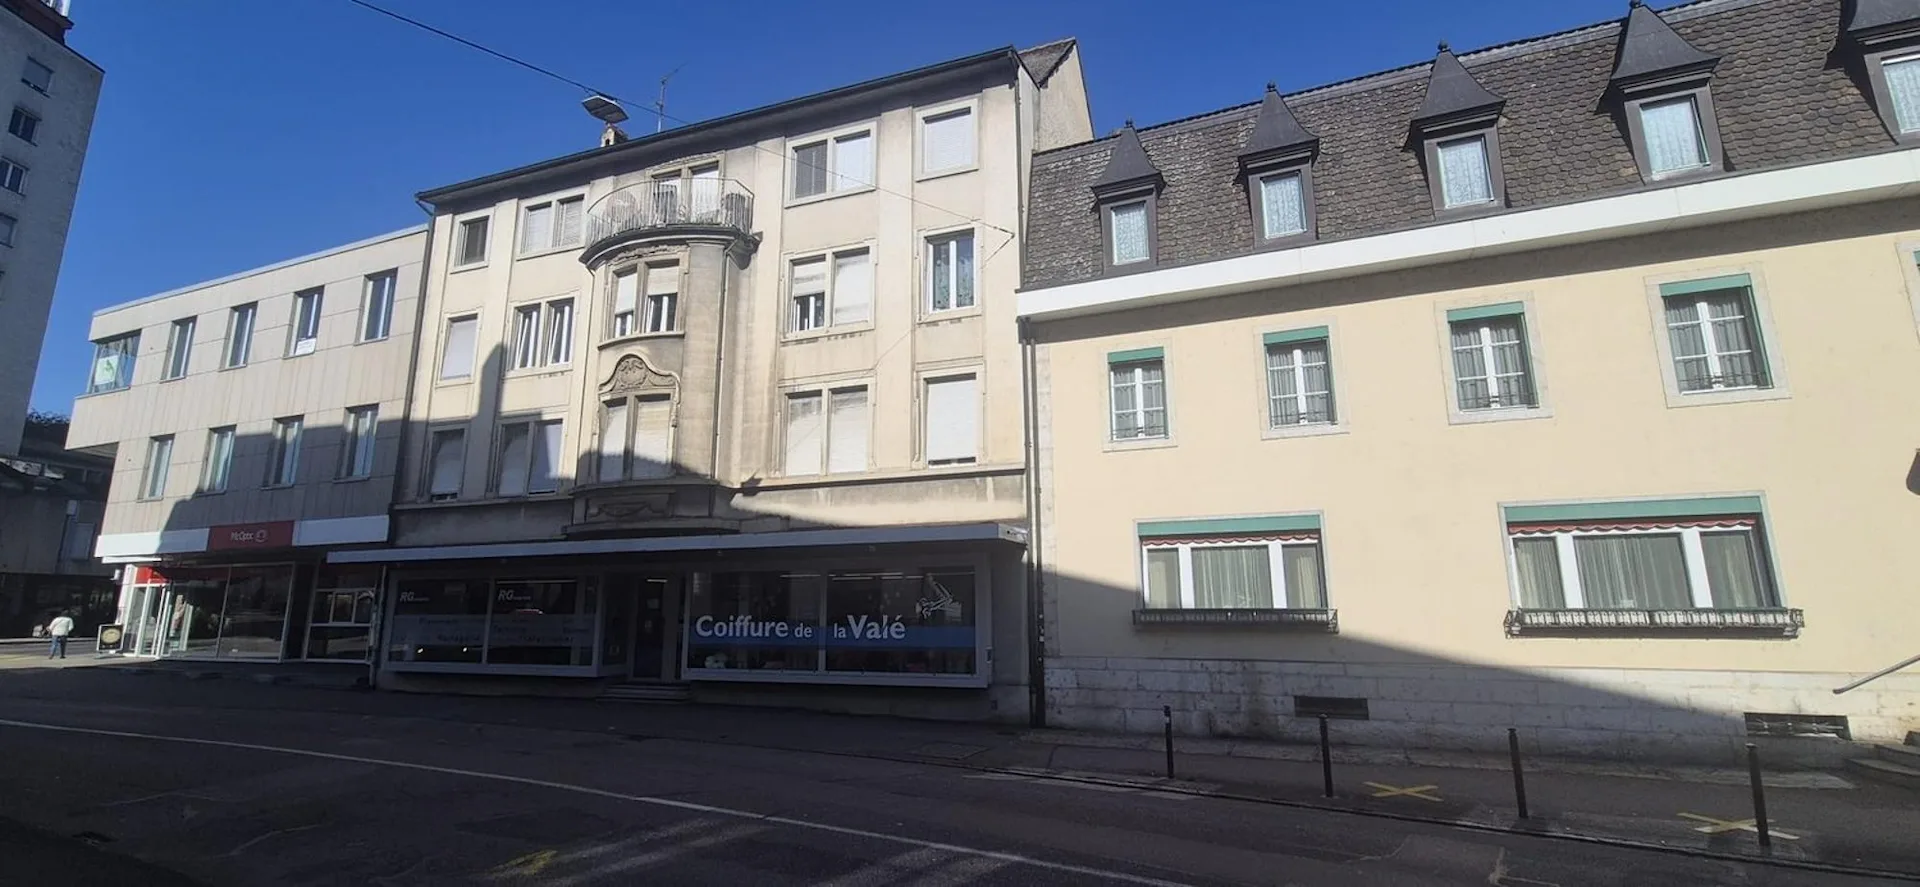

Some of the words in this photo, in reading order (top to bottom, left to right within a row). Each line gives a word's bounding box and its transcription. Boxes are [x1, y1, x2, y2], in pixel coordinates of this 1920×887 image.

[399, 591, 415, 602] RG
[497, 589, 514, 601] RG
[695, 615, 789, 638] Coiffure
[794, 623, 813, 638] de
[833, 623, 846, 639] la
[847, 614, 906, 640] Valé
